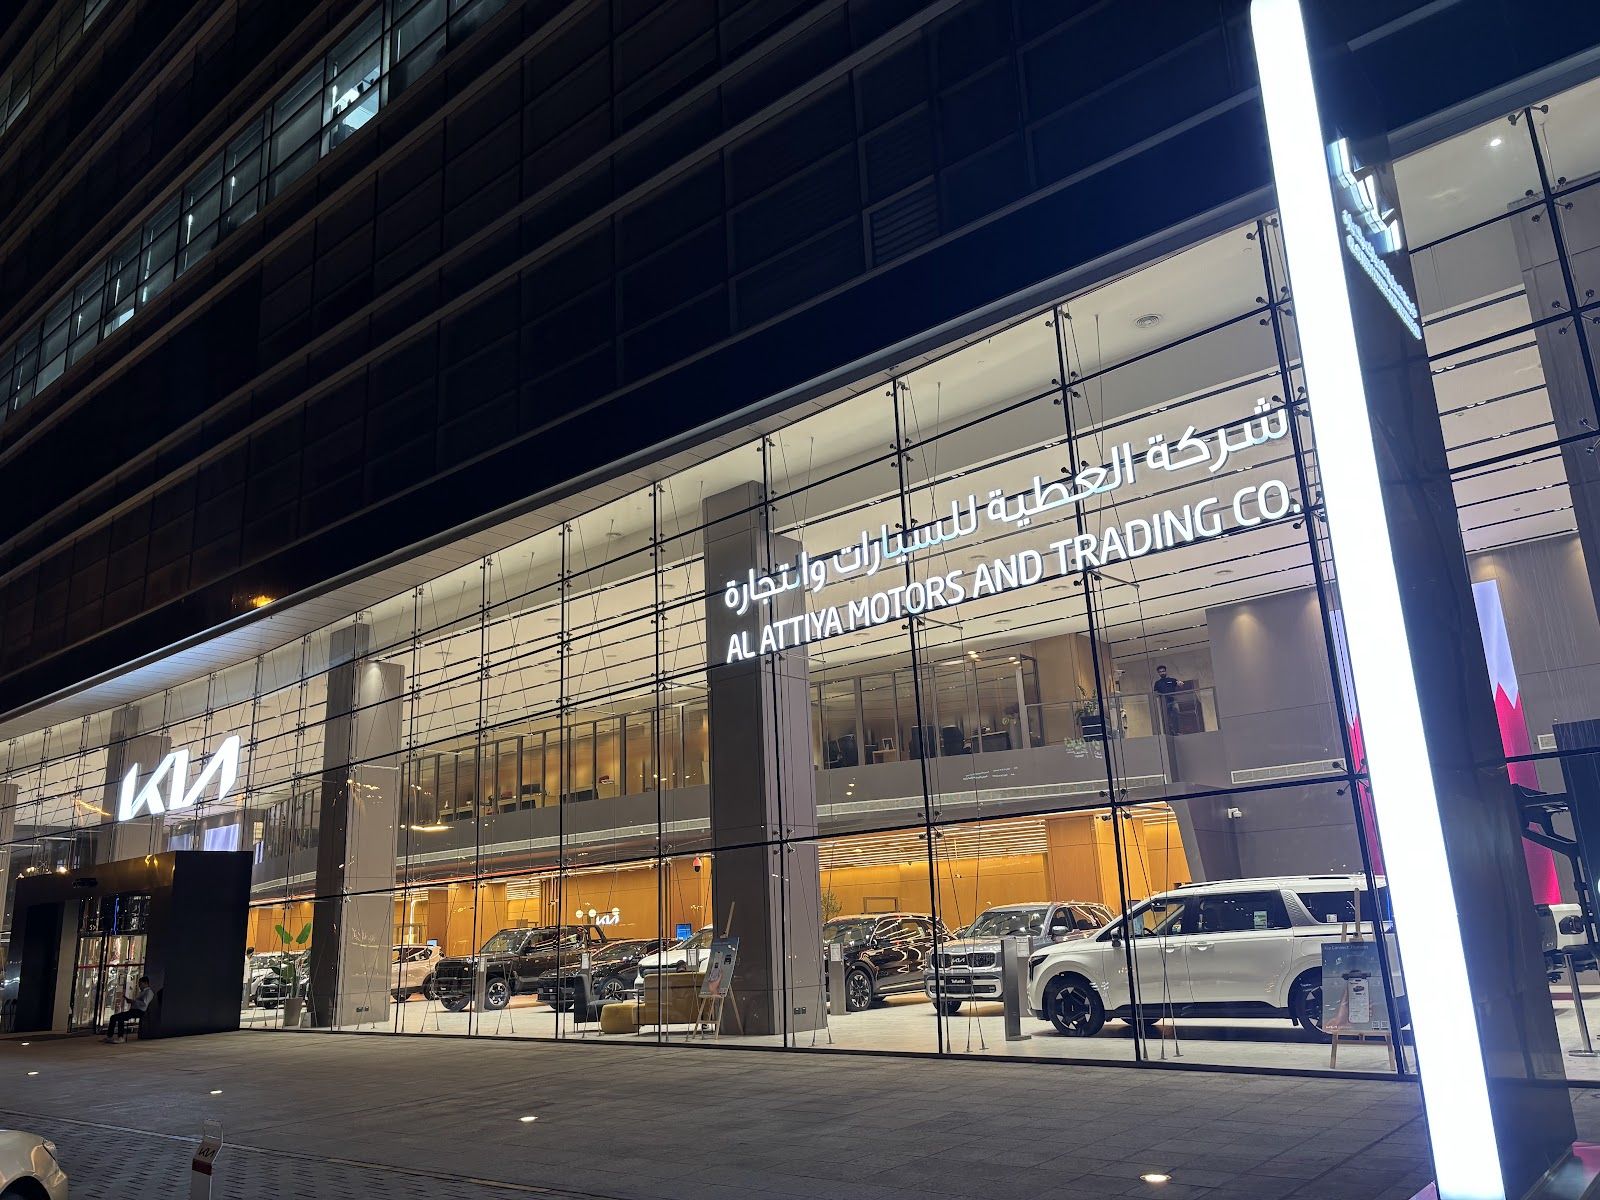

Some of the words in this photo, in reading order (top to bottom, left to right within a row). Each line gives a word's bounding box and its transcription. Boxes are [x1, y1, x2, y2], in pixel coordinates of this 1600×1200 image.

[1146, 398, 1288, 473] شركة
[987, 442, 1134, 527] العطية
[726, 631, 756, 663] AL
[759, 606, 843, 655] ATTIYA
[849, 570, 966, 630] MOTORS
[973, 549, 1043, 599] AND
[1050, 496, 1223, 577] TRADING
[1233, 479, 1301, 526] CO.
[833, 494, 977, 576] للسيارات
[724, 551, 826, 615] والتجارة
[118, 735, 240, 821] KIA
